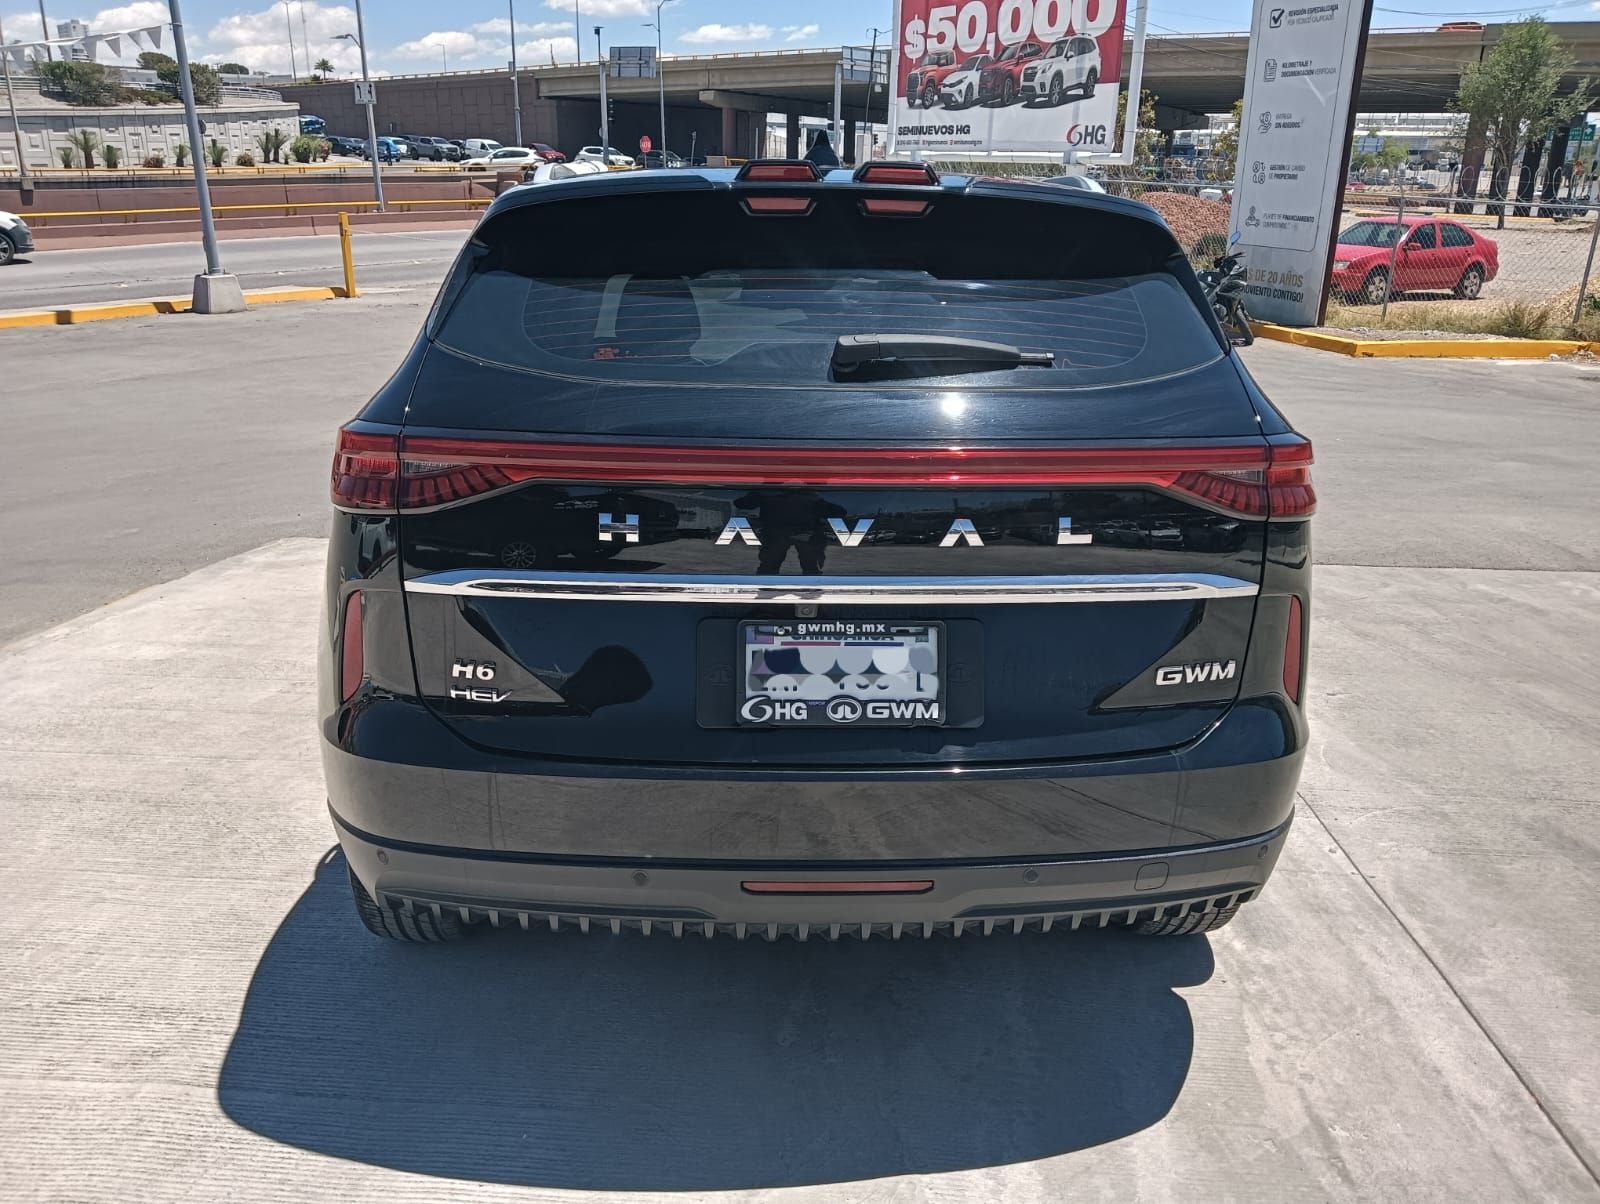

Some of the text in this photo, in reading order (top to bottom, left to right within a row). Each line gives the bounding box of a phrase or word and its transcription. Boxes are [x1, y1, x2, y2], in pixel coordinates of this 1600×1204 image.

[904, 0, 1118, 63] $50,000
[897, 124, 971, 136] SEMINUEVOS HG
[1083, 124, 1107, 146] HG
[1254, 269, 1266, 283] DE
[1267, 271, 1278, 284] 20
[1279, 270, 1304, 288] AÑOS
[1273, 288, 1304, 303] CONTIGO!
[597, 511, 1093, 548] HAVAL
[797, 621, 886, 634] gwmhg.mx
[451, 659, 496, 681] H6
[1155, 660, 1237, 687] GWM
[449, 686, 512, 703] HEV
[774, 702, 939, 721] HG GWM
